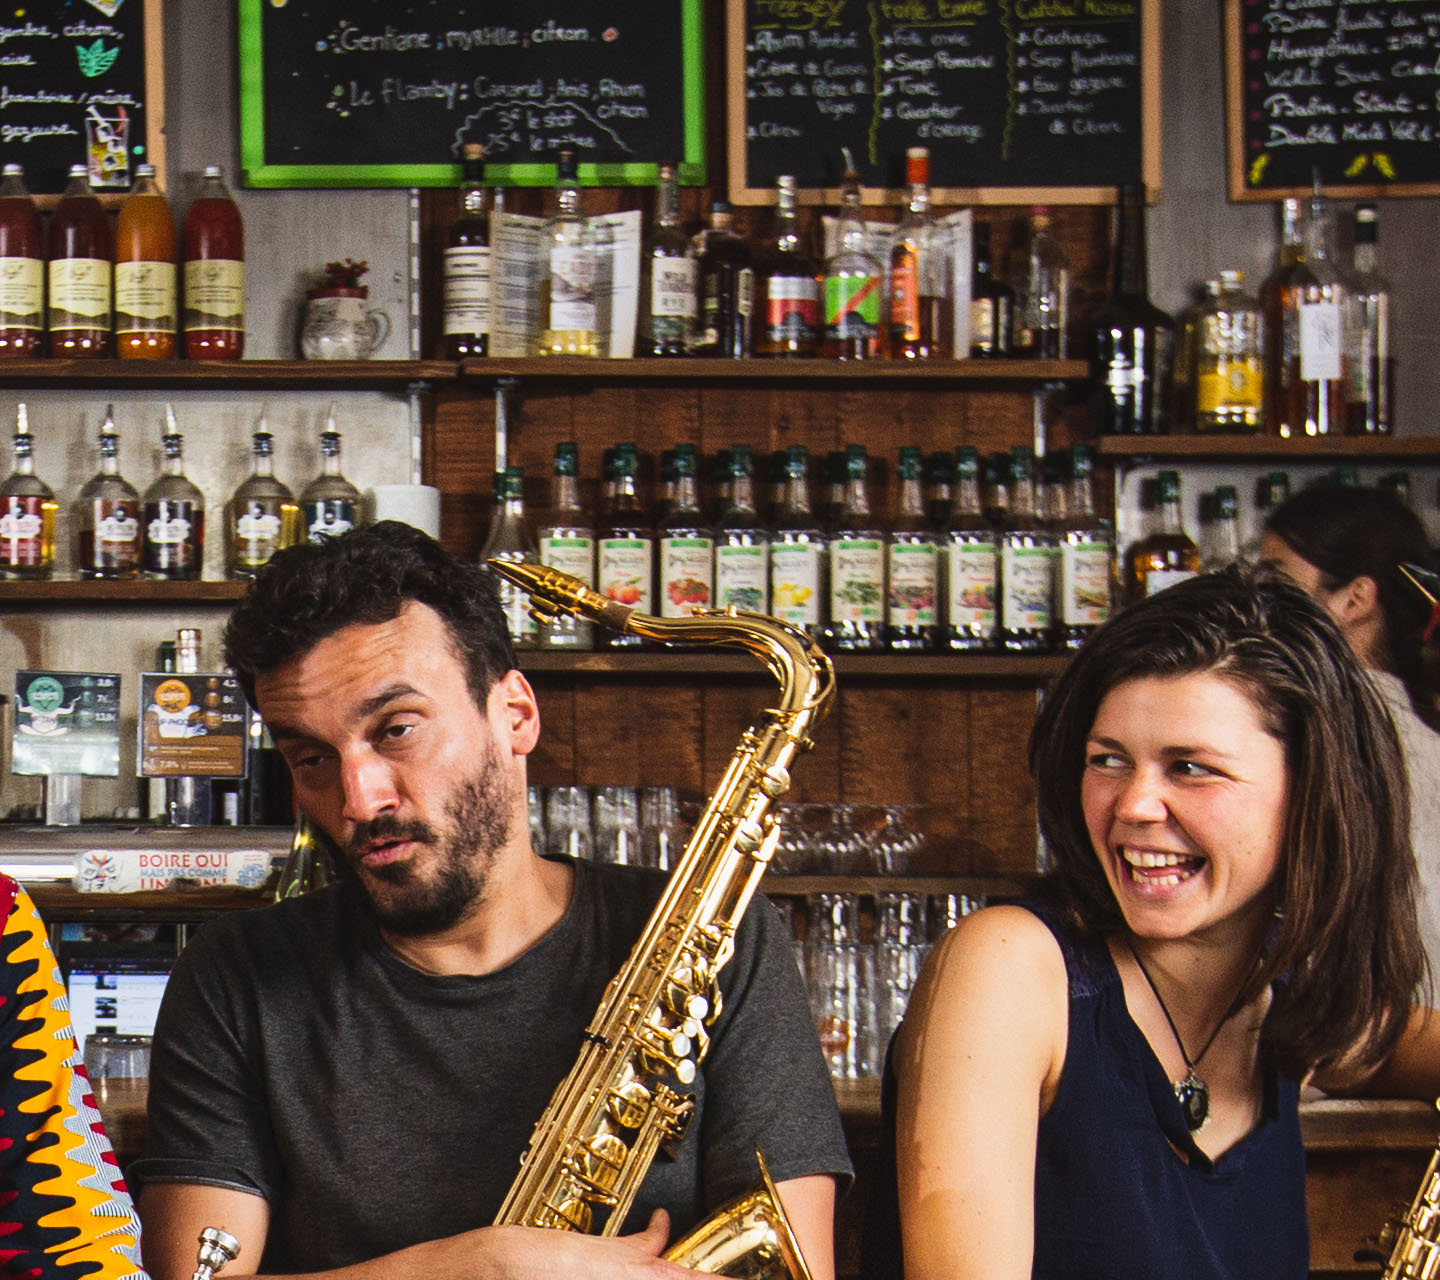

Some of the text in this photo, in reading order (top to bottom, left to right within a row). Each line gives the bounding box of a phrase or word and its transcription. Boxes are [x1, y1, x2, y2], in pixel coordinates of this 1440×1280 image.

[139, 854, 228, 868] BOIRE OUI
[140, 869, 227, 877] MAIS PAS COMME
